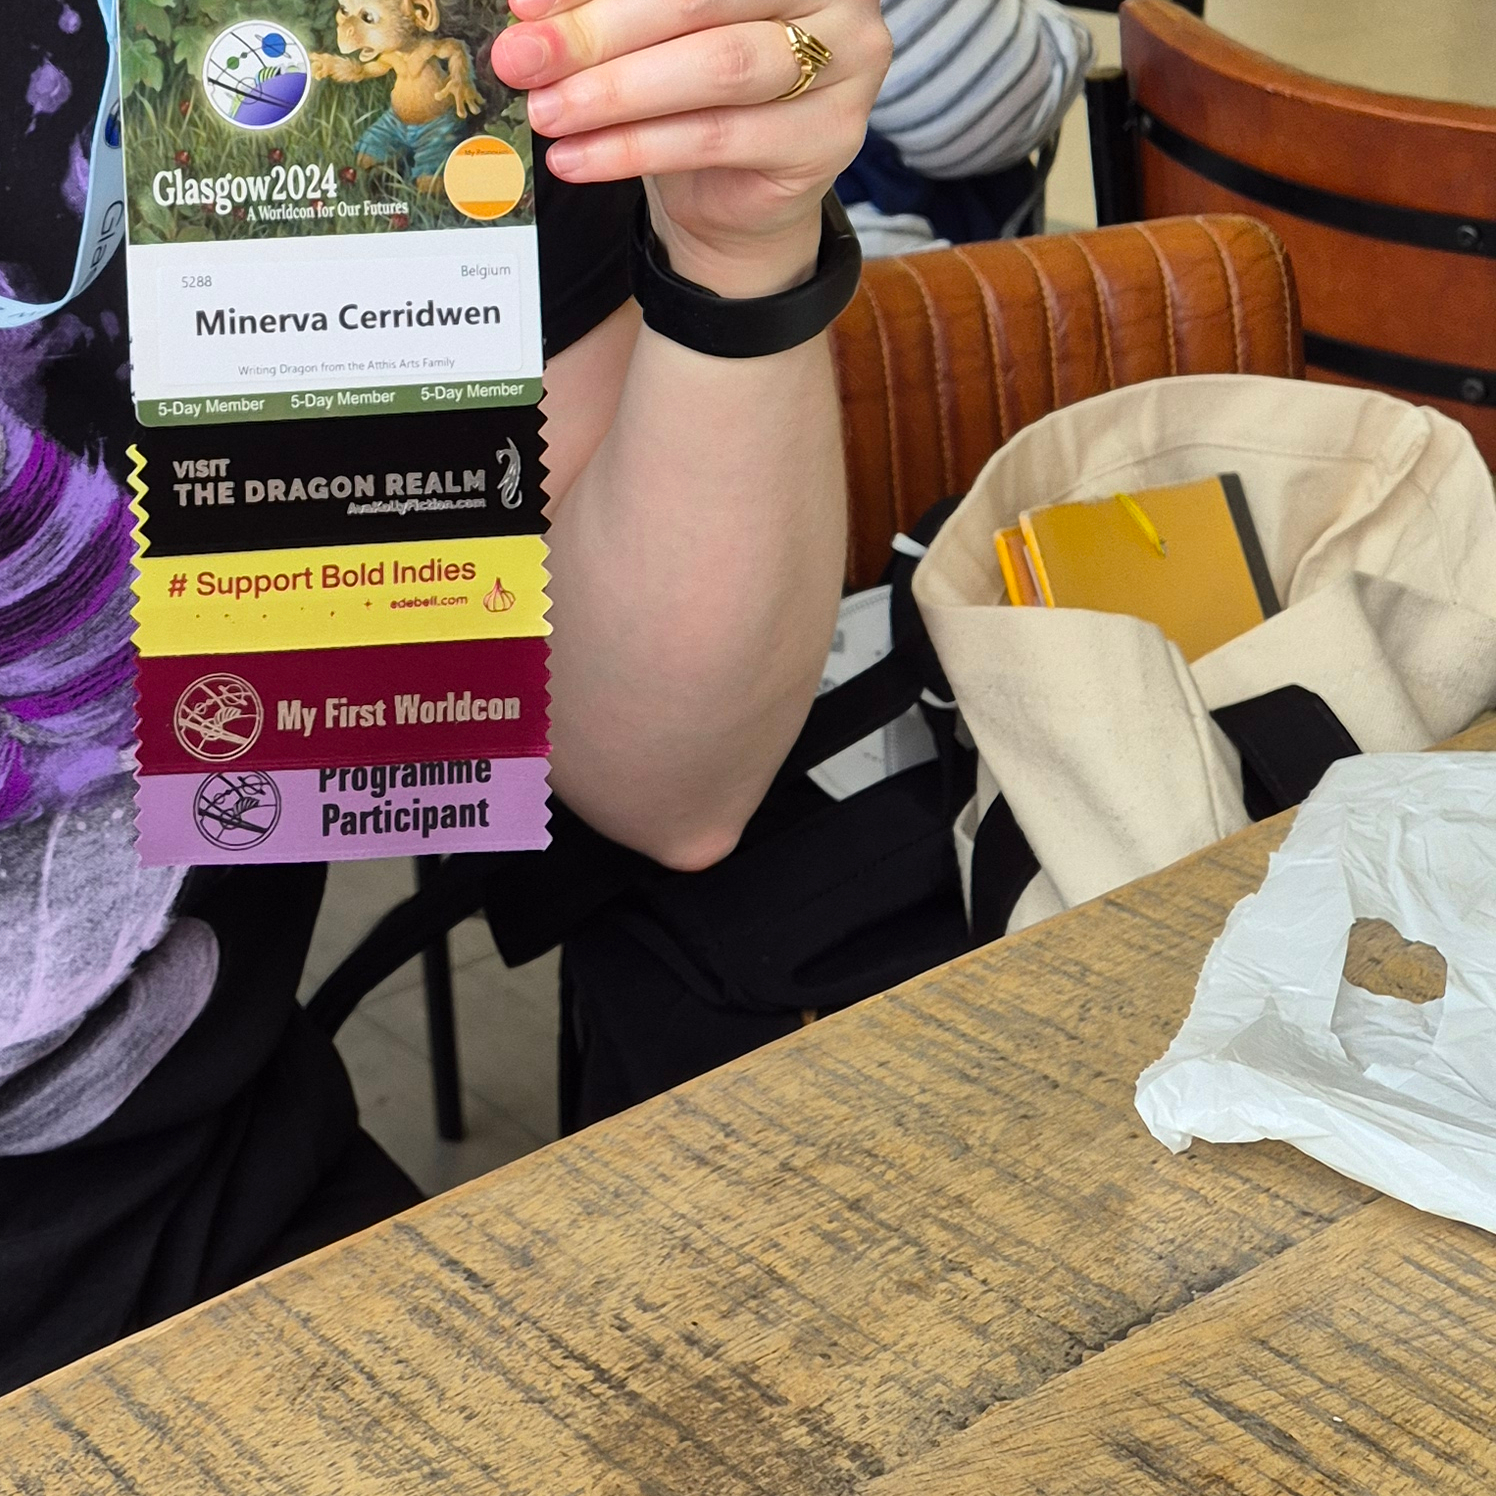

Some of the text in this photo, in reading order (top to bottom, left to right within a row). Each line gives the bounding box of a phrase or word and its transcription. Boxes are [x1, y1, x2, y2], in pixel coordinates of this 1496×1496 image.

[152, 162, 337, 215] Glasgow2024
[247, 199, 409, 222] A Worldcon for Our Futures
[181, 263, 512, 288] 5288 Belgium
[194, 299, 502, 337] Minerva Cerridwen
[237, 357, 455, 377] Writing Dragon from the Atthis Arts Family
[157, 381, 525, 418] 5-Day Member 5-Day Member 5-Day Member
[172, 458, 230, 479] VISIT
[172, 469, 486, 507] THE DRAGON REALM
[167, 558, 476, 600] # Support Bold Indies
[390, 593, 468, 609] edebell.com
[277, 691, 520, 736] My First Worldcon
[318, 758, 492, 798] Programme
[322, 798, 490, 838] Participant
